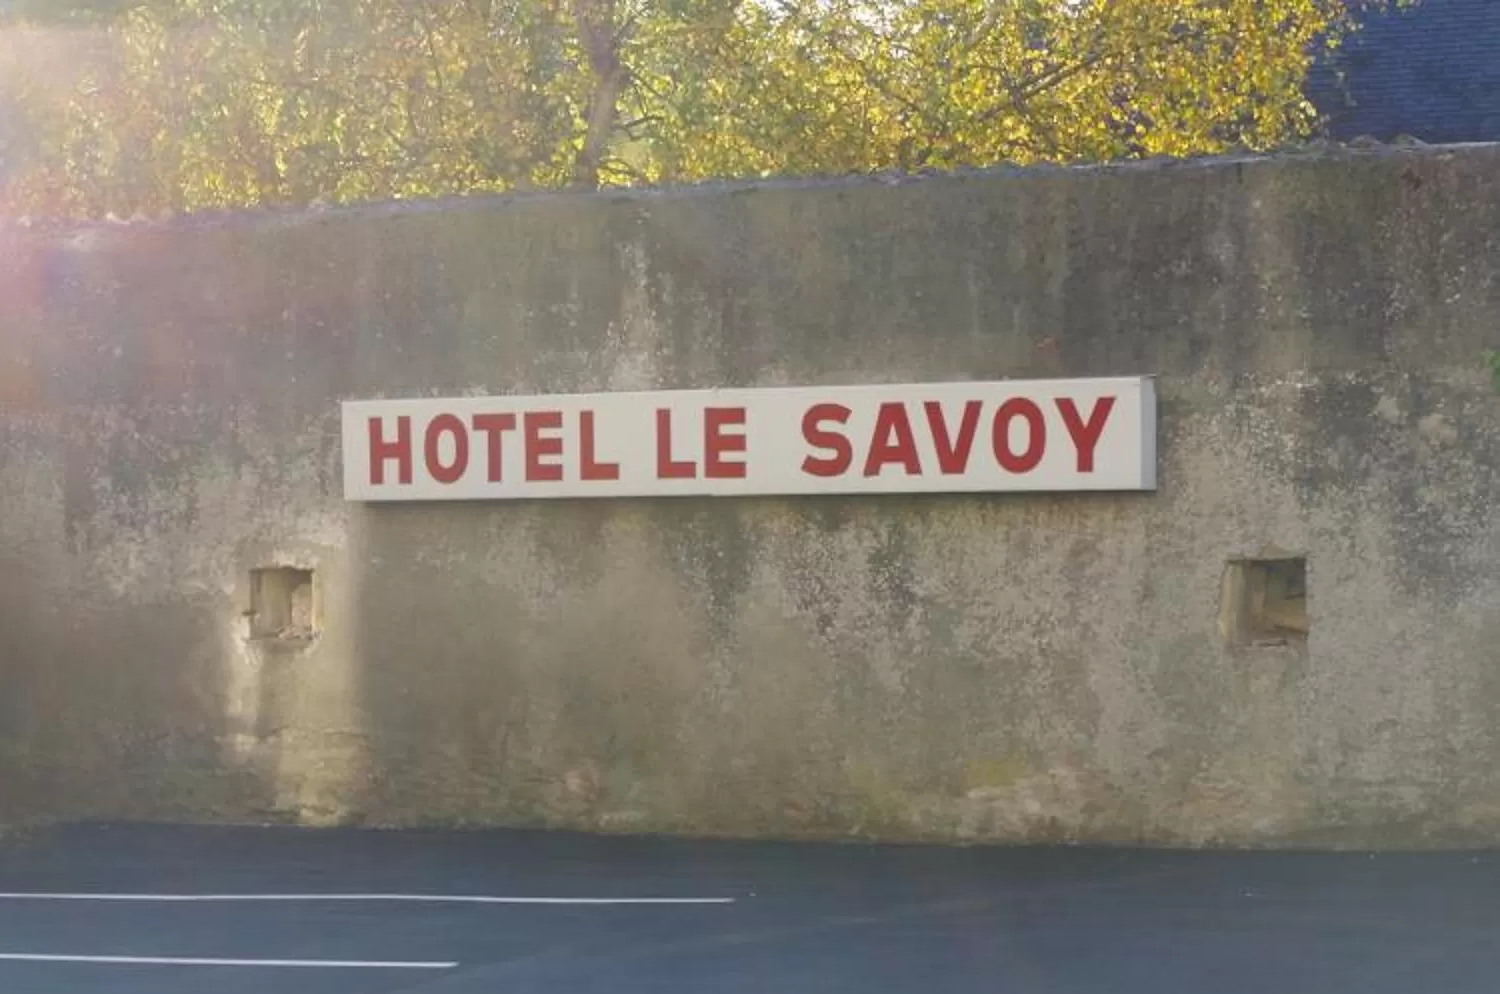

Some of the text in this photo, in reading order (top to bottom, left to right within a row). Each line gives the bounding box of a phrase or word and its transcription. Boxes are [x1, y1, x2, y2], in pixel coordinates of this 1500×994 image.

[367, 395, 1117, 485] HOTEL LE SAVOY
